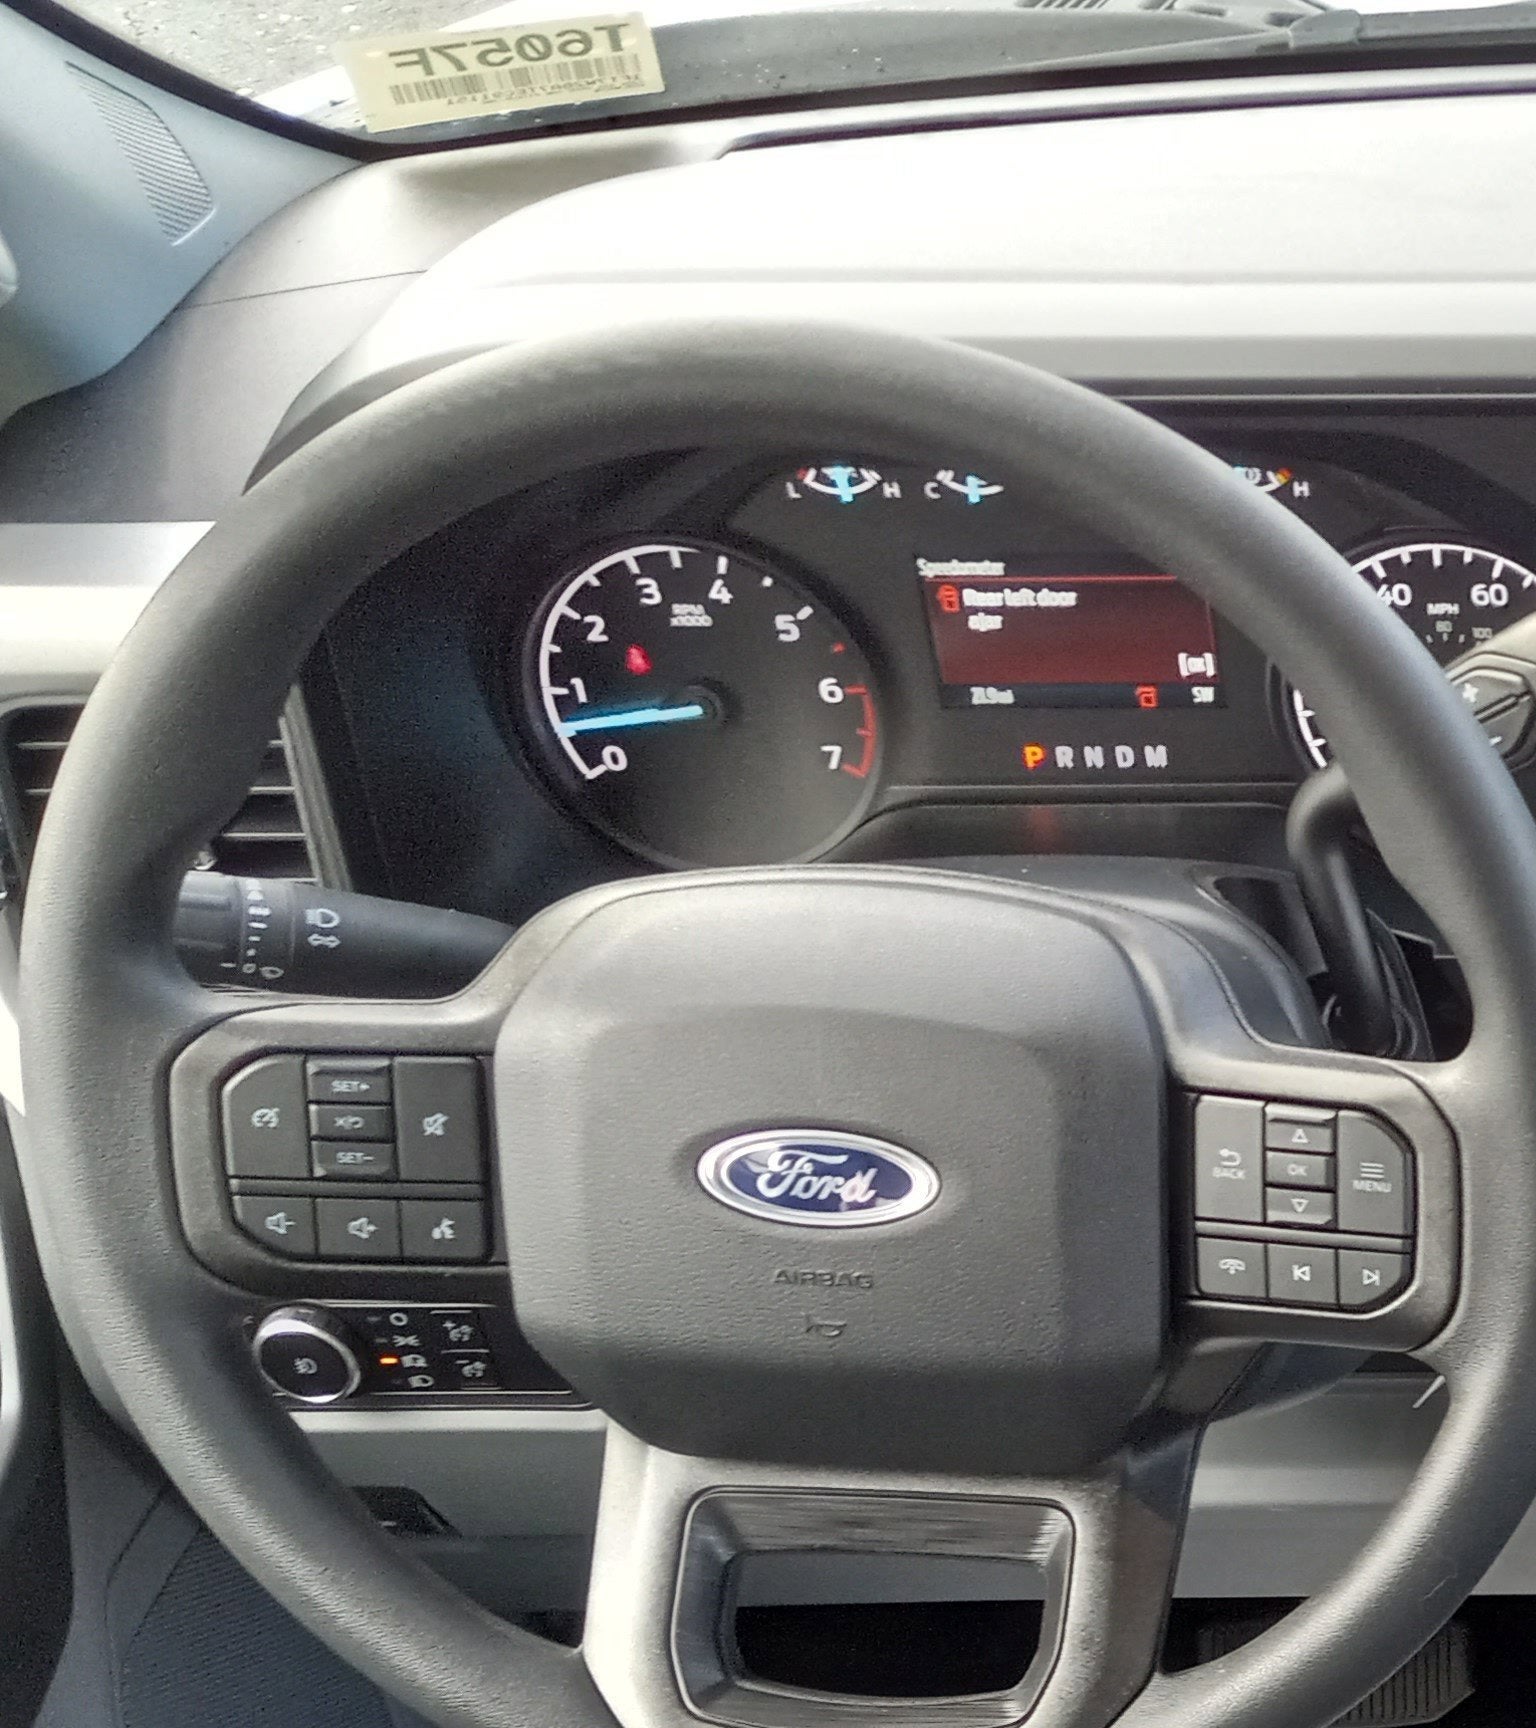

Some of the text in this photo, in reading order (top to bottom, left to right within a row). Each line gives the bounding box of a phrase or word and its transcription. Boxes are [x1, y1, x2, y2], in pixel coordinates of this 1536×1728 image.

[786, 483, 800, 498] L
[883, 483, 901, 498] H
[924, 483, 941, 499] C
[1293, 481, 1310, 498] H
[635, 578, 662, 604] 3
[709, 579, 733, 603] 4
[1470, 583, 1508, 607] 60
[1426, 603, 1459, 615] MPH
[583, 616, 609, 641] 2
[775, 615, 800, 642] 5
[570, 678, 588, 703] 1
[818, 678, 844, 704] 6
[602, 745, 627, 771] 0
[821, 745, 842, 770] 7
[1024, 745, 1168, 768] P R N D M
[755, 1149, 878, 1203] Ford
[1212, 1165, 1246, 1181] BACK
[1286, 1163, 1307, 1177] OK
[1353, 1178, 1392, 1194] MENU
[773, 1268, 875, 1290] AIRBAG
